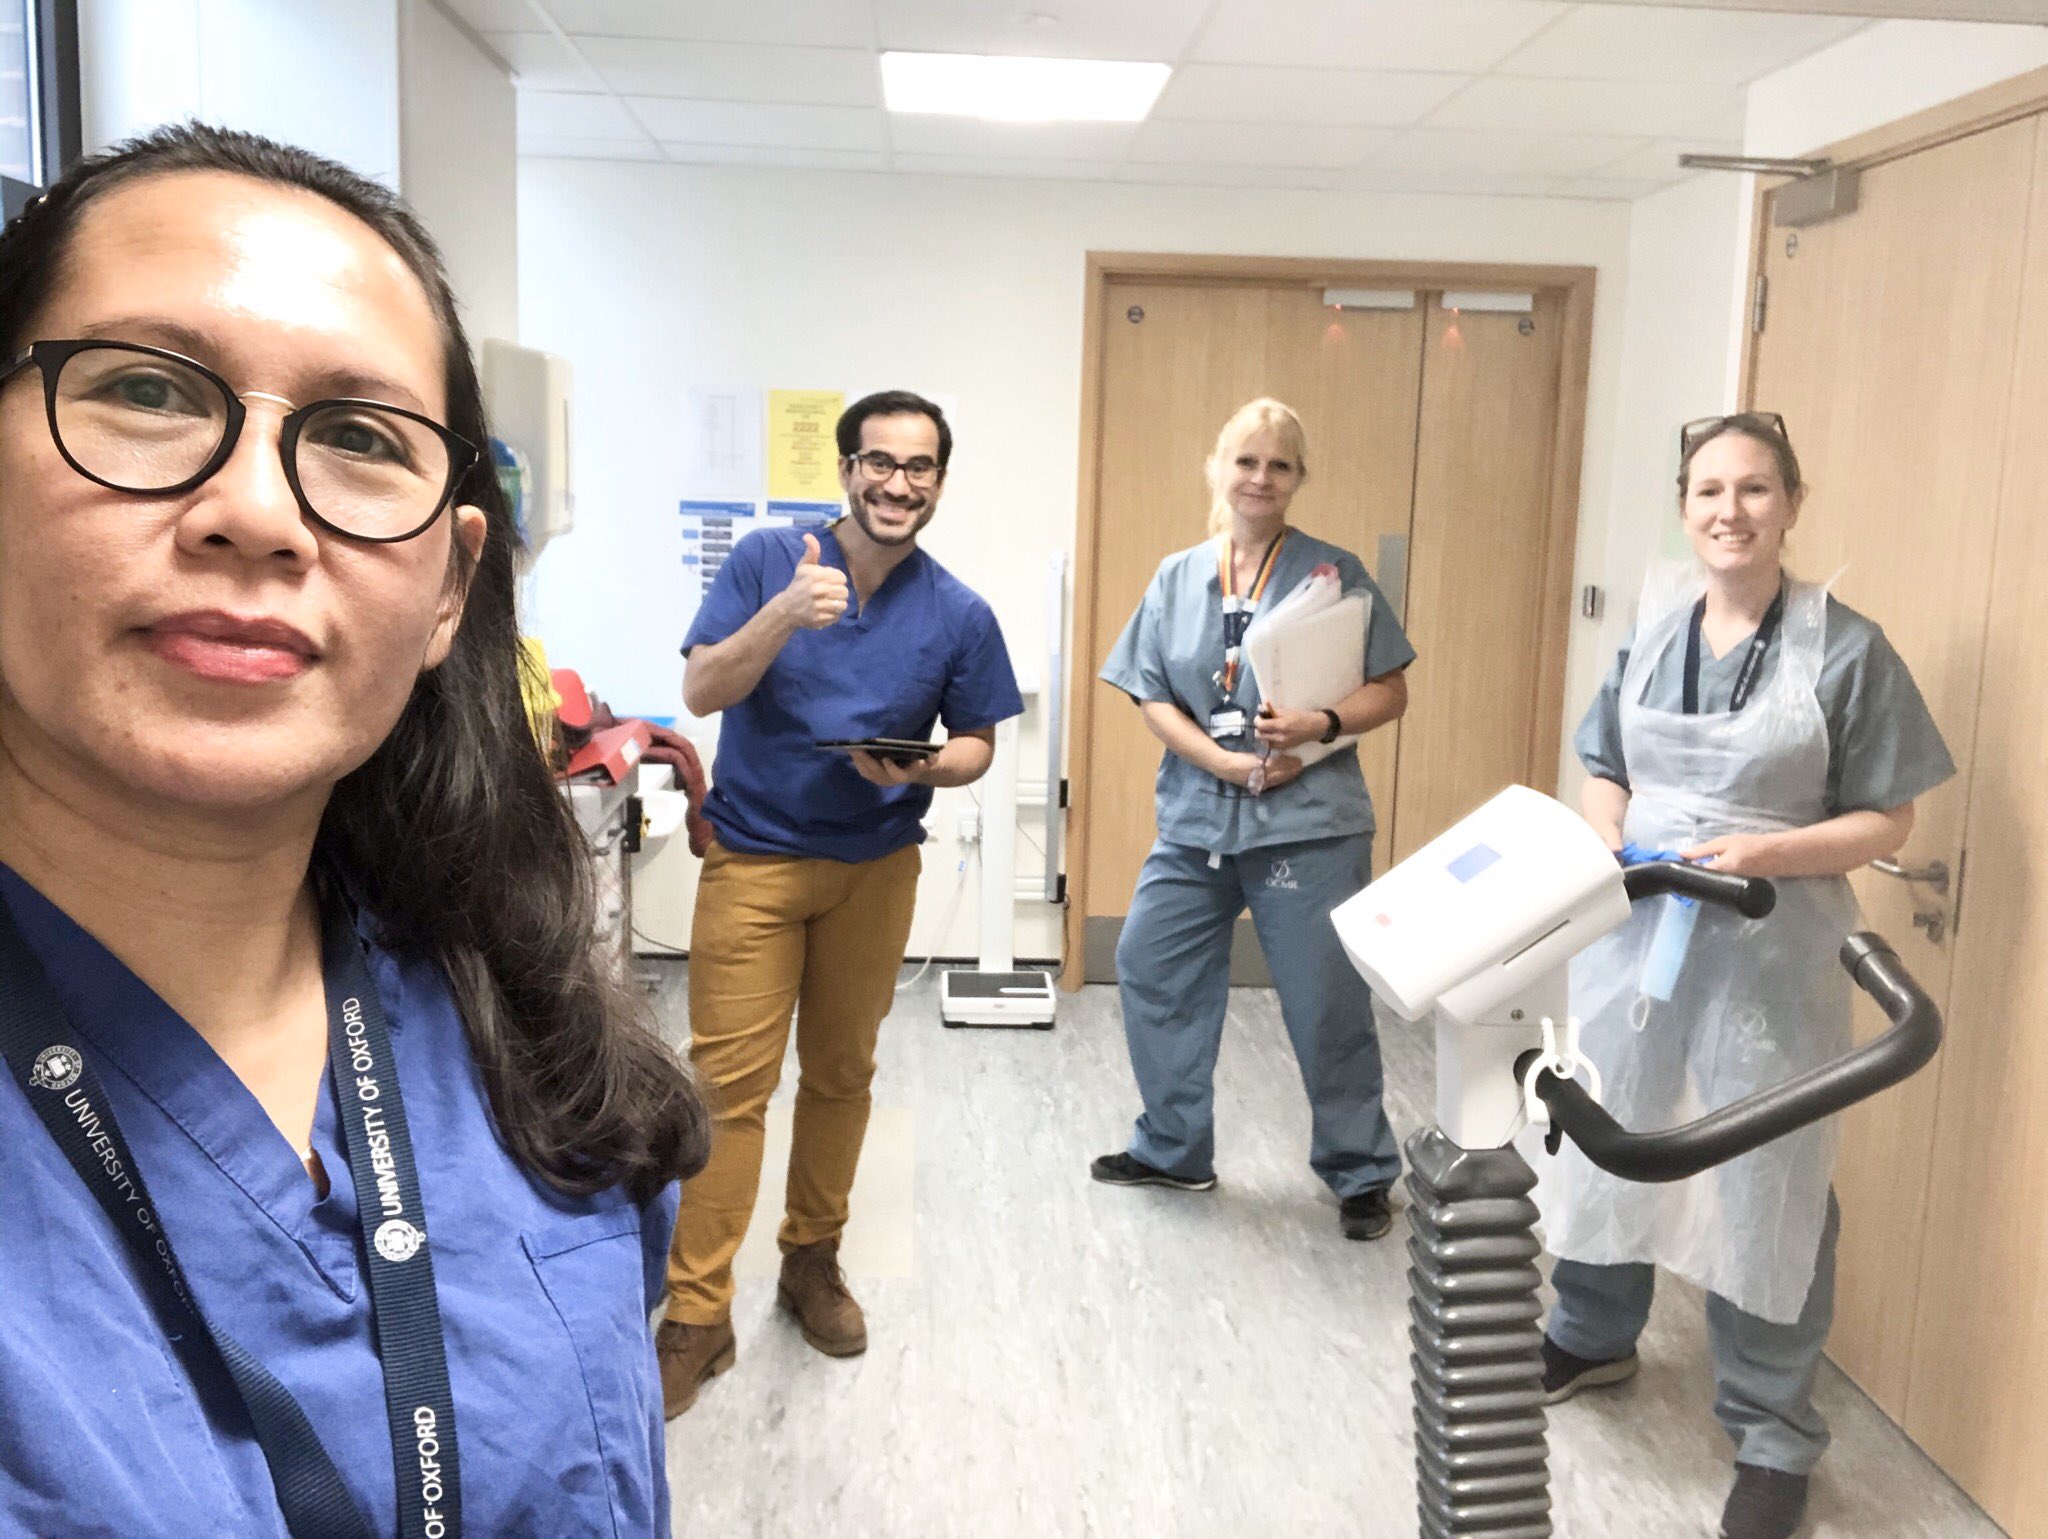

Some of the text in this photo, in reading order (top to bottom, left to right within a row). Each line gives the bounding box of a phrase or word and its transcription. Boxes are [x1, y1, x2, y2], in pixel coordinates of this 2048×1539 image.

[342, 997, 374, 1072] OXFORD
[356, 1075, 380, 1101] OF
[64, 1088, 140, 1203] UNIVERSITY
[137, 1207, 157, 1234] OF
[362, 1106, 403, 1217] UNIVERSITY
[413, 1406, 446, 1539] OF OXFORD
